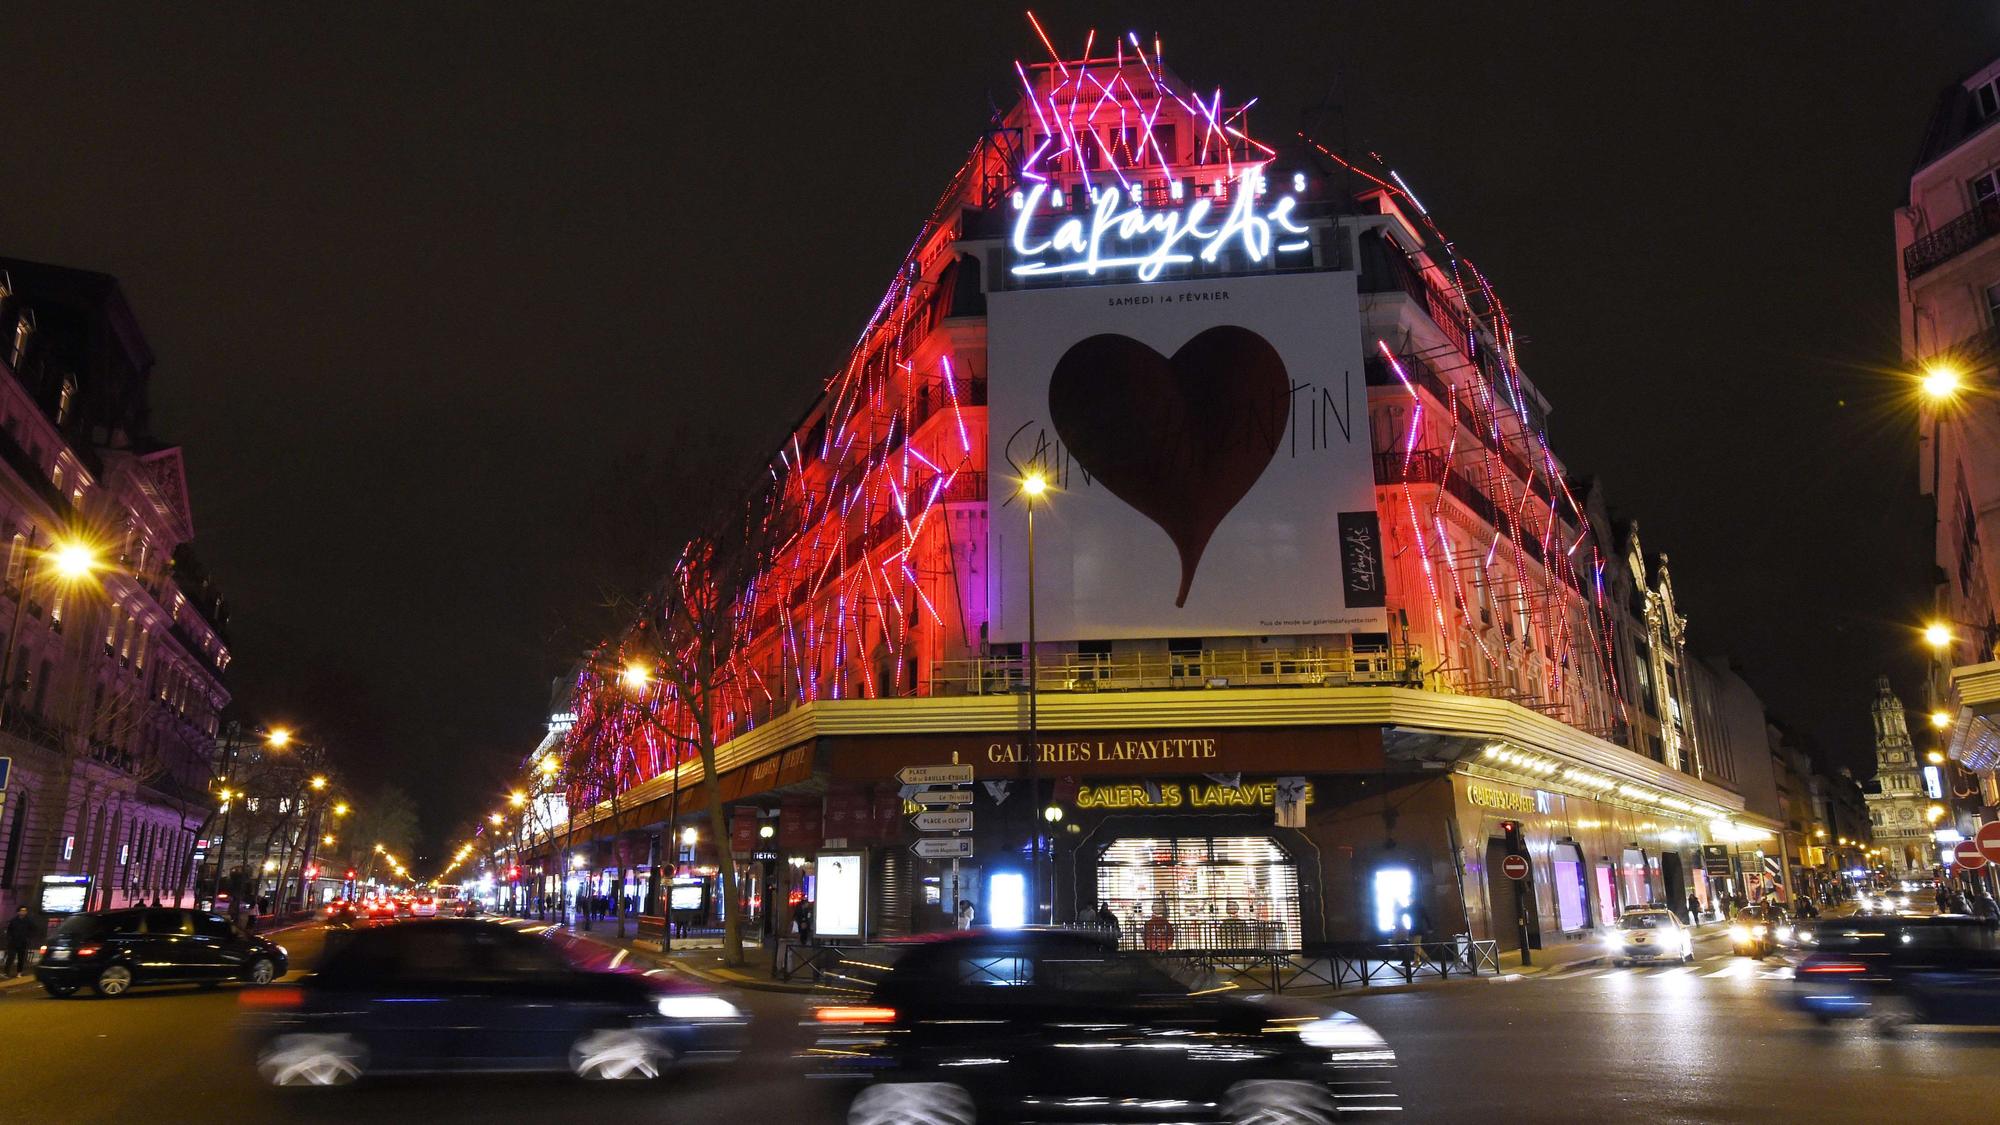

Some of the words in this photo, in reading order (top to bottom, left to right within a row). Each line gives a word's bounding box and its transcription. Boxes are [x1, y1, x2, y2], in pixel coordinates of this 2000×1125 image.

[1108, 296, 1154, 307] SAMEDI
[1160, 296, 1172, 304] 14
[1178, 290, 1231, 303] FÉVRIER
[1098, 737, 1217, 761] LAFAYETTE
[1077, 784, 1182, 808] GALERES
